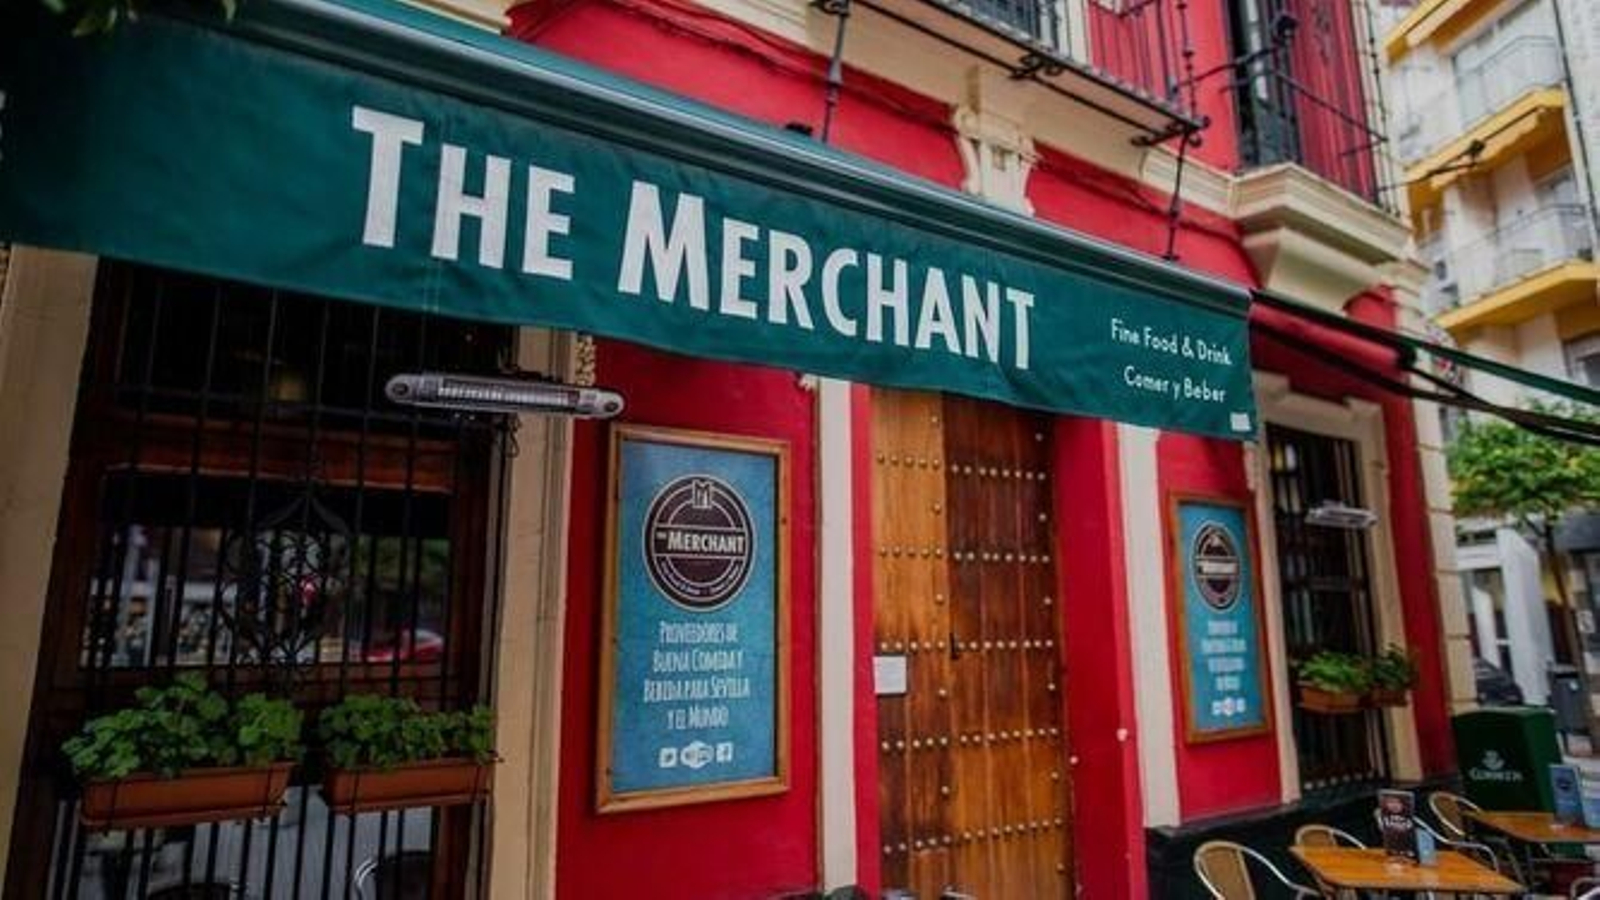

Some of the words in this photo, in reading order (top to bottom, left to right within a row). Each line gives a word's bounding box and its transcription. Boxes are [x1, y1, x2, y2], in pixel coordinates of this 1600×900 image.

[352, 105, 575, 280] THE
[618, 180, 1035, 370] MERCHANT
[1111, 318, 1140, 344] Fine
[1143, 326, 1178, 354] Food
[1181, 335, 1195, 359] &
[1197, 339, 1232, 366] Drink
[1124, 365, 1169, 393] Comer
[1172, 381, 1181, 400] y
[1183, 377, 1226, 403] Beber
[668, 531, 745, 553] MERCHANT
